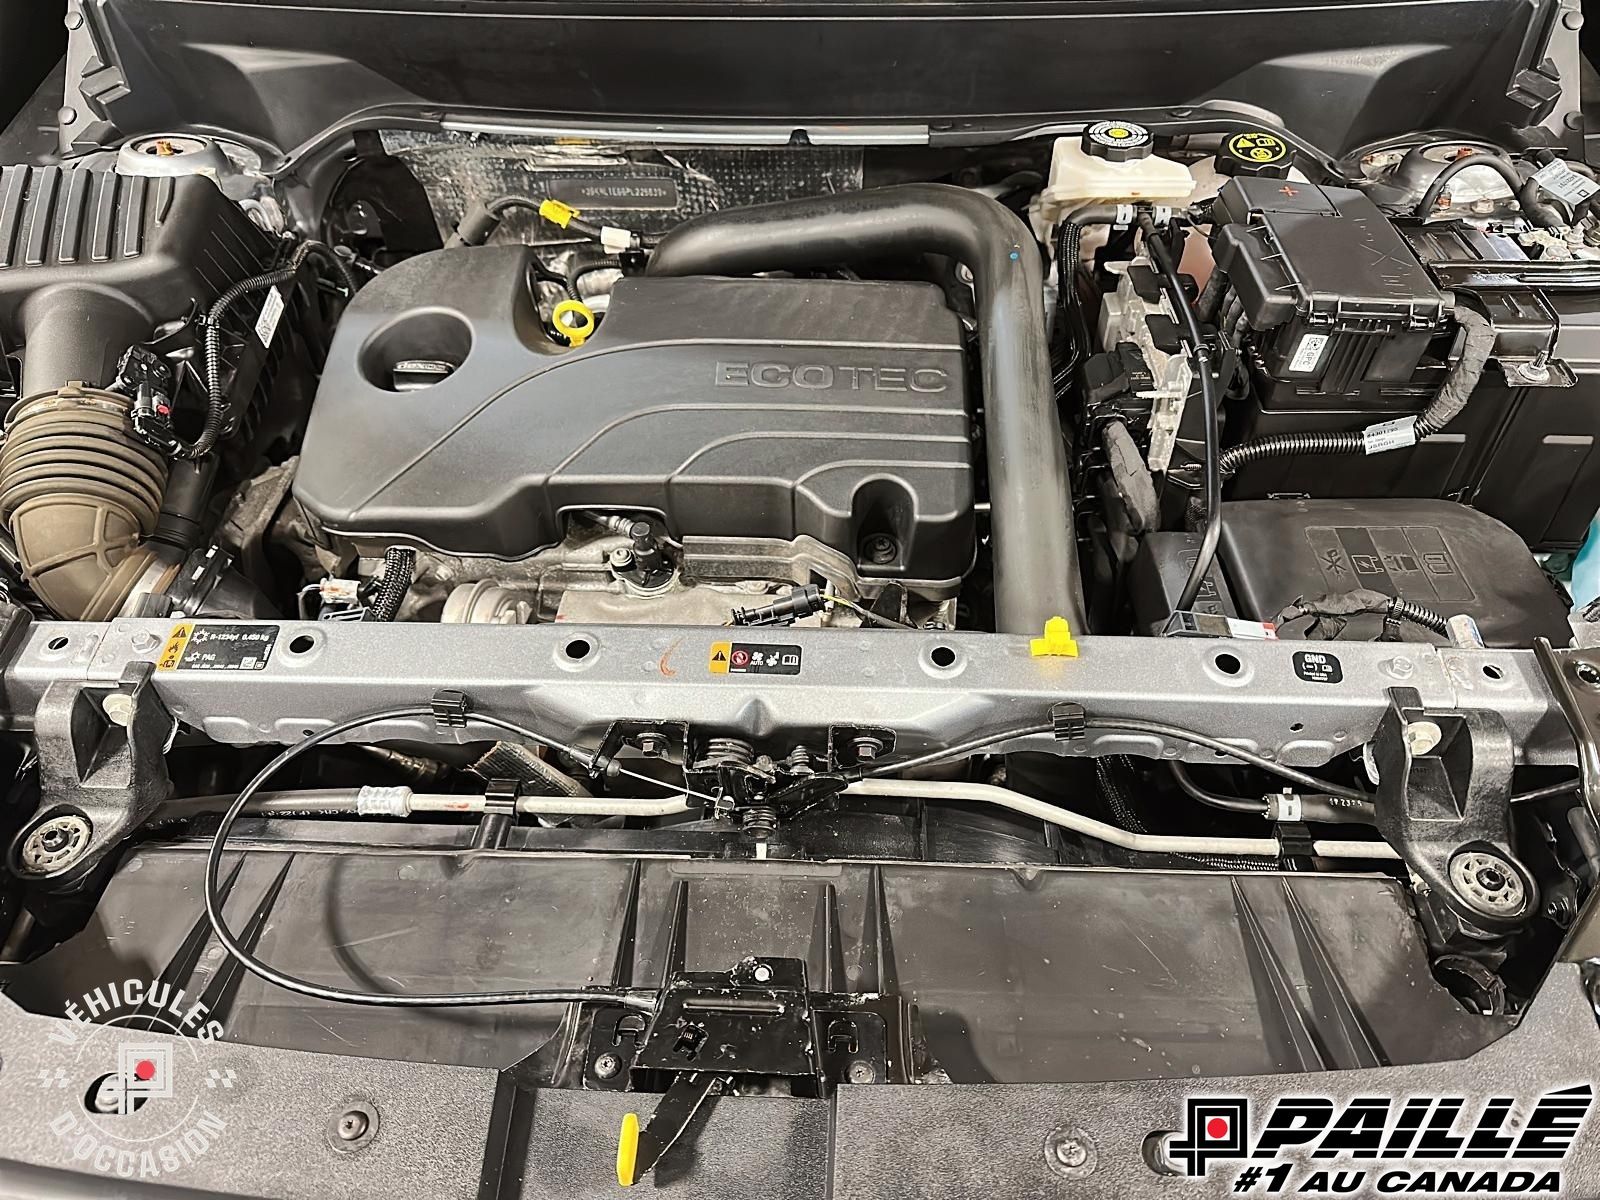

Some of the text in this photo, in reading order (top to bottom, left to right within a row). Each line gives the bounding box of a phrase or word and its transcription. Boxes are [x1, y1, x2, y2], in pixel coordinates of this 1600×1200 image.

[714, 360, 948, 393] ECOTEC
[201, 653, 217, 661] PAG
[1304, 653, 1327, 665] GND
